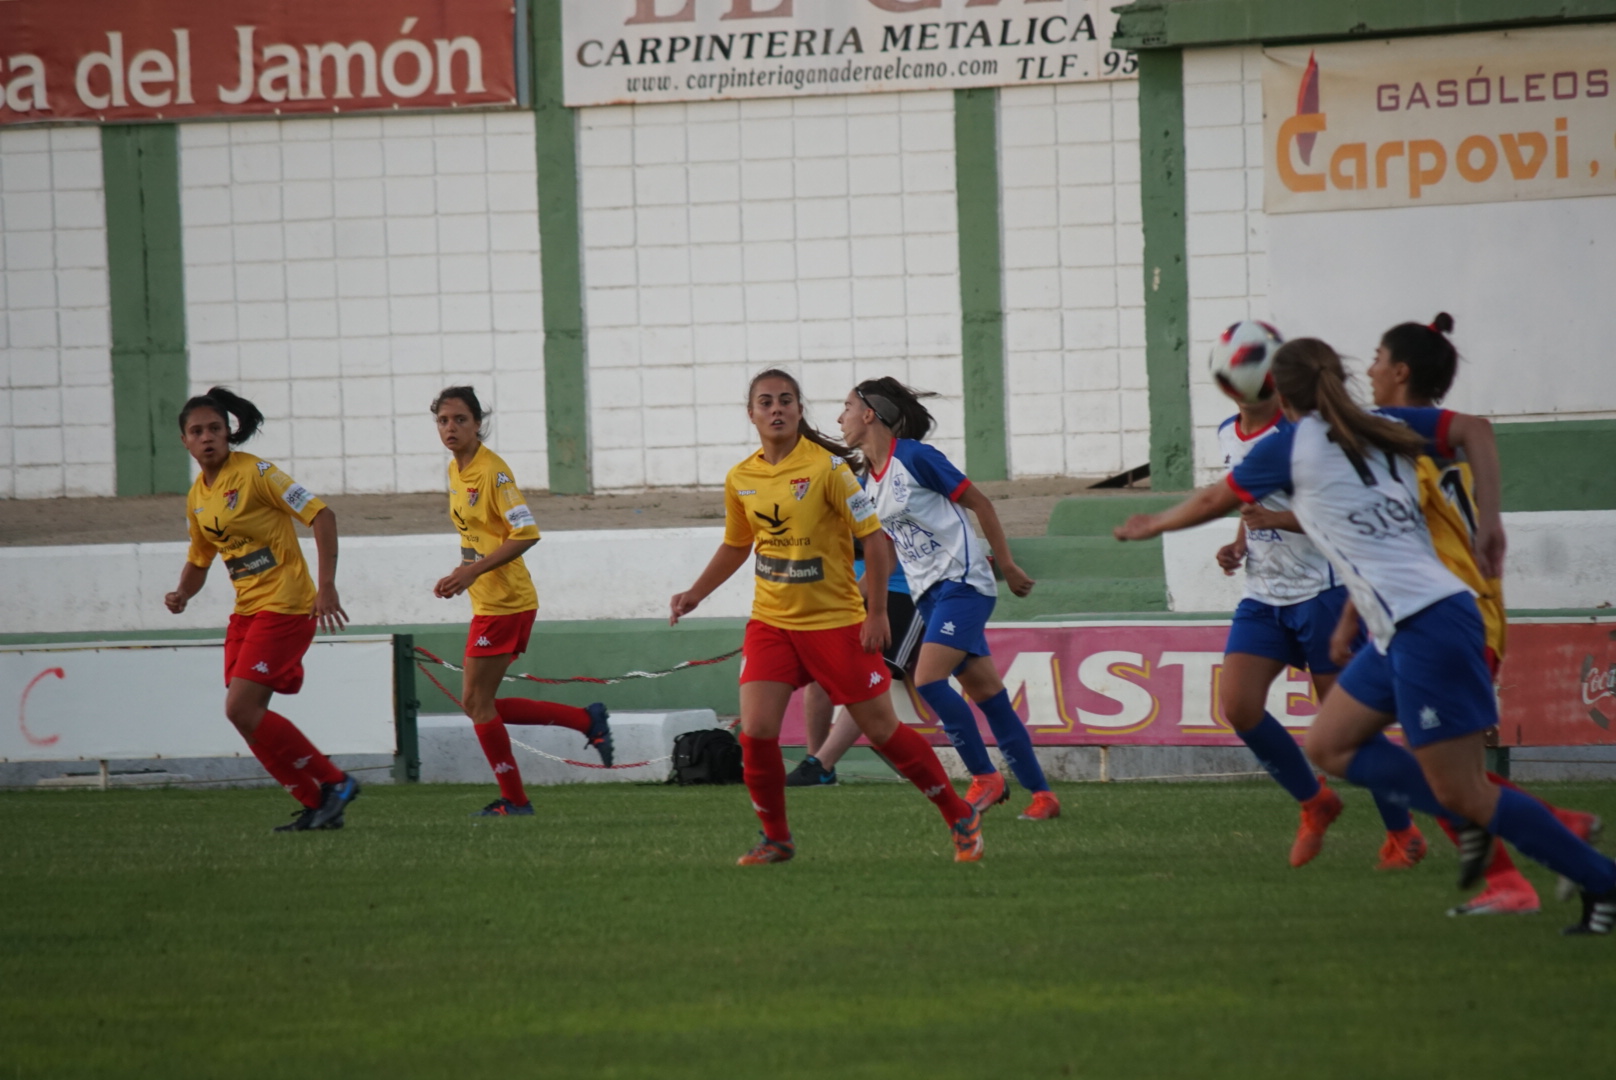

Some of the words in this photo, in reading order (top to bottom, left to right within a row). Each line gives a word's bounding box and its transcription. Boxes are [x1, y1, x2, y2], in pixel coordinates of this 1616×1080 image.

[0, 52, 52, 113] a
[75, 28, 195, 109] del
[217, 16, 487, 105] Jamón
[576, 26, 865, 69] CARPINTERIA
[880, 12, 1098, 53] METALICA
[1376, 65, 1609, 112] GASÓLEOS
[789, 565, 819, 578] bank
